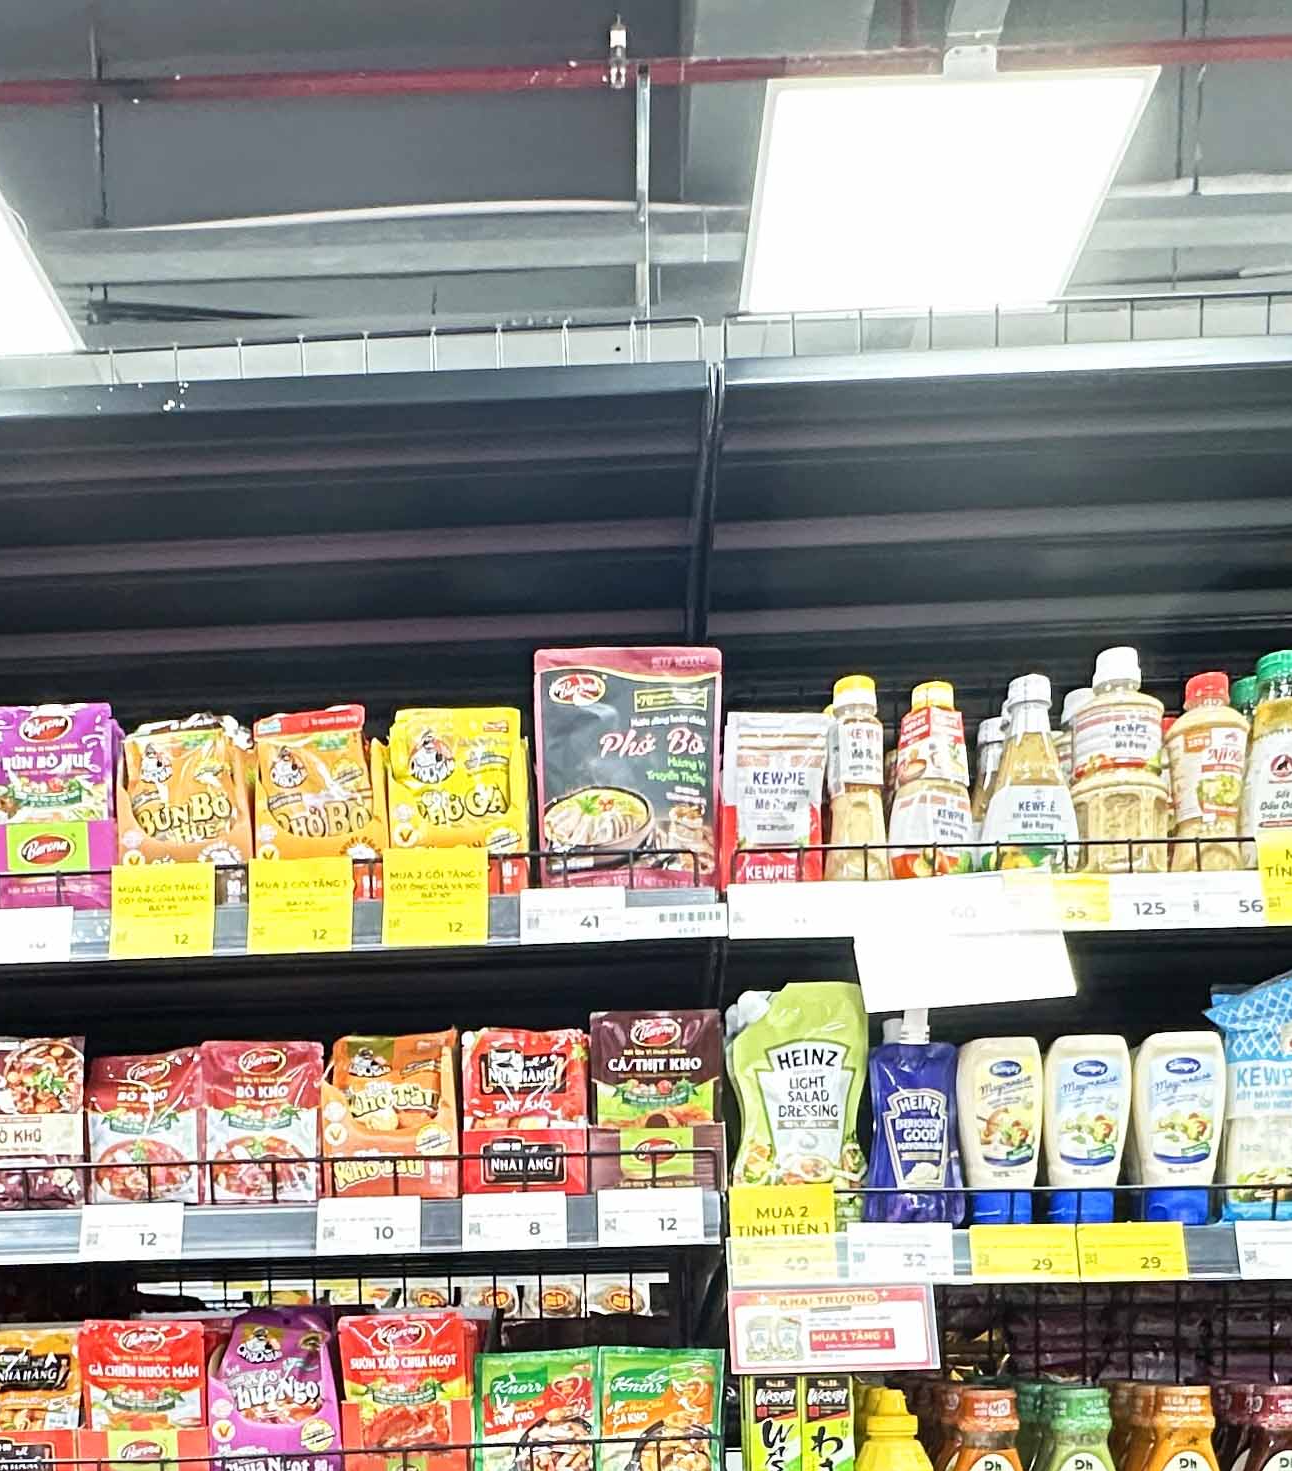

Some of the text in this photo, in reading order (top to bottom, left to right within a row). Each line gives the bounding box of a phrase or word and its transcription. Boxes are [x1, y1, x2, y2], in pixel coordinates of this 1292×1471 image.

[753, 770, 806, 786] KEWPIE
[747, 864, 796, 880] KEWPIE
[1133, 902, 1166, 915] 125
[580, 916, 599, 928] 41
[777, 1049, 838, 1070] HEINZ
[789, 1076, 825, 1090] LIGHT
[788, 1090, 830, 1103] SALAD
[779, 1102, 838, 1118] DRESSING
[902, 1128, 937, 1141] GOOD
[757, 1206, 808, 1219] MUA 2
[529, 1222, 541, 1235] 8
[659, 1218, 677, 1231] 12
[1141, 1257, 1161, 1269] 29
